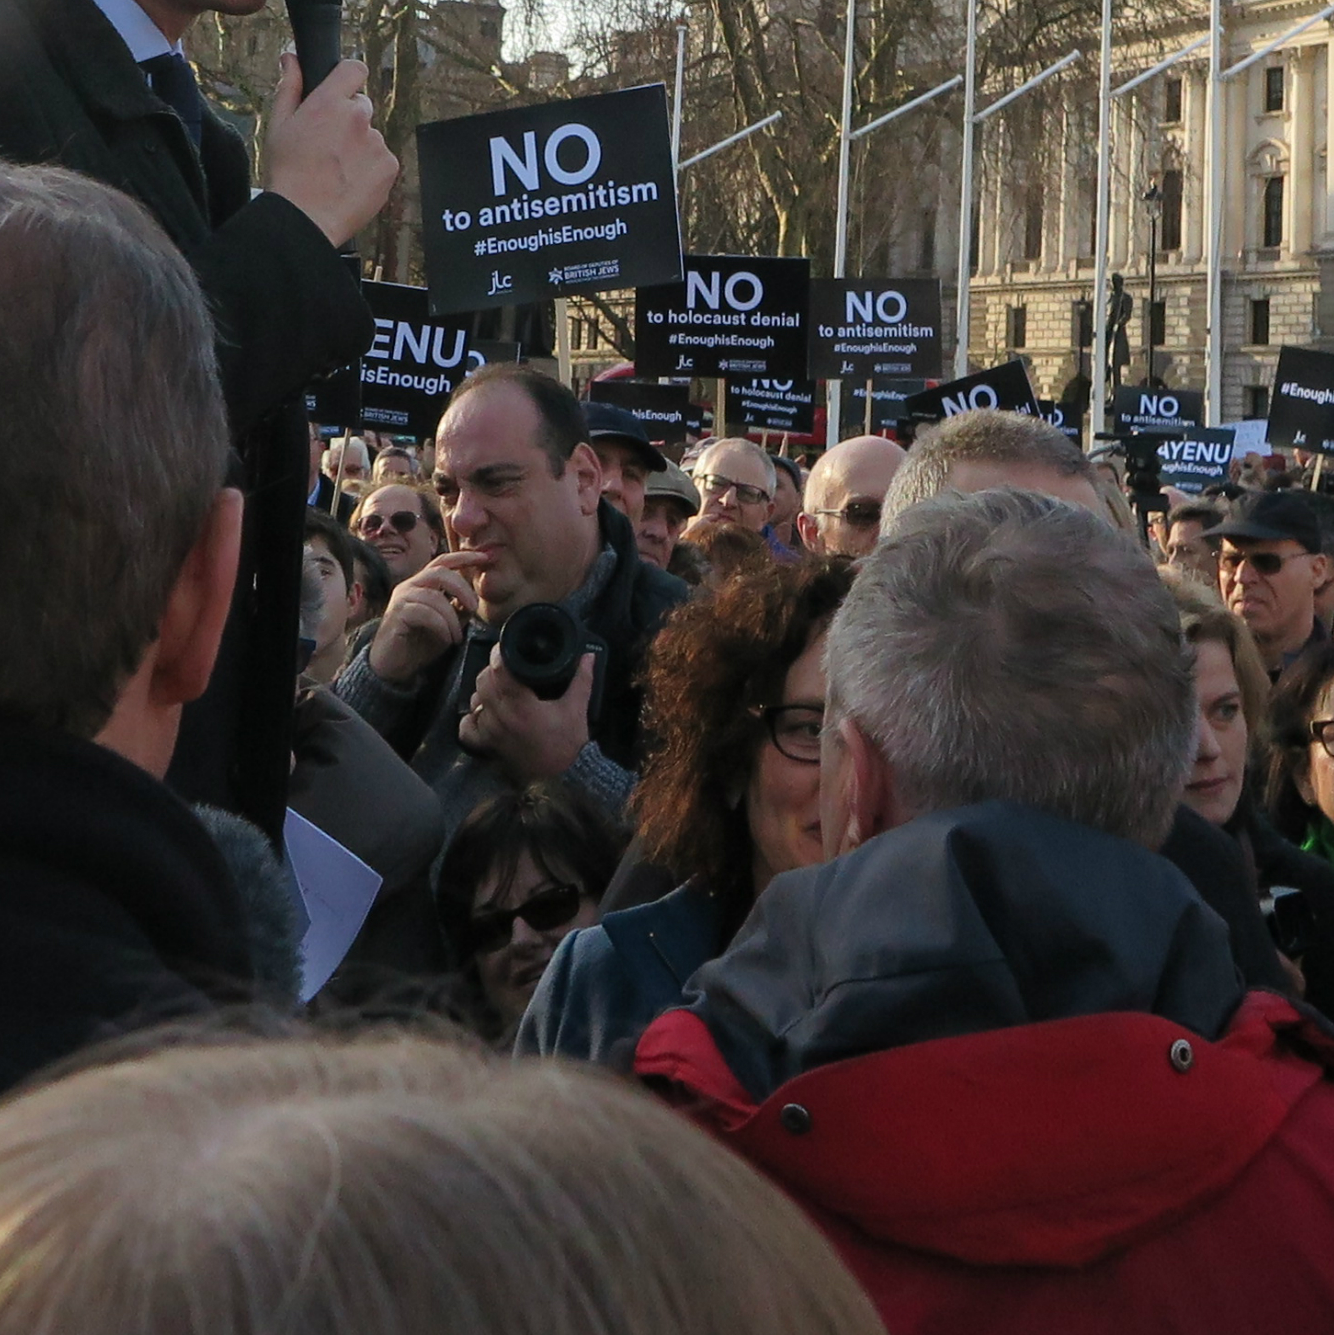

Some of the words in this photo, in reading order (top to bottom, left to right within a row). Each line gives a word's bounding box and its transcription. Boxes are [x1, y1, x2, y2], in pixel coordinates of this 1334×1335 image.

[489, 123, 601, 197] NO
[442, 209, 471, 232] to
[478, 180, 658, 227] antisemitism
[474, 218, 628, 257] #EnoughisEnough
[564, 268, 596, 280] BRITISH
[598, 265, 620, 275] JEWS
[686, 270, 763, 312] NO
[647, 310, 663, 324] to
[668, 309, 746, 326] holocaust
[750, 312, 800, 327] denial
[845, 290, 907, 324] NO
[669, 333, 775, 350] #EnoughisEnough
[818, 325, 834, 338] to
[837, 323, 934, 338] antisemitism
[365, 317, 466, 369] ENU
[834, 342, 917, 355] #EnoughisEnough
[360, 363, 451, 395] isEnough
[730, 385, 740, 395] to
[742, 386, 783, 400] holocaust
[785, 392, 812, 403] denial
[941, 383, 998, 417] NO
[1140, 394, 1179, 417] NO
[1121, 413, 1130, 422] to
[1133, 415, 1195, 427] antisemitism
[1157, 441, 1231, 464] AYENU
